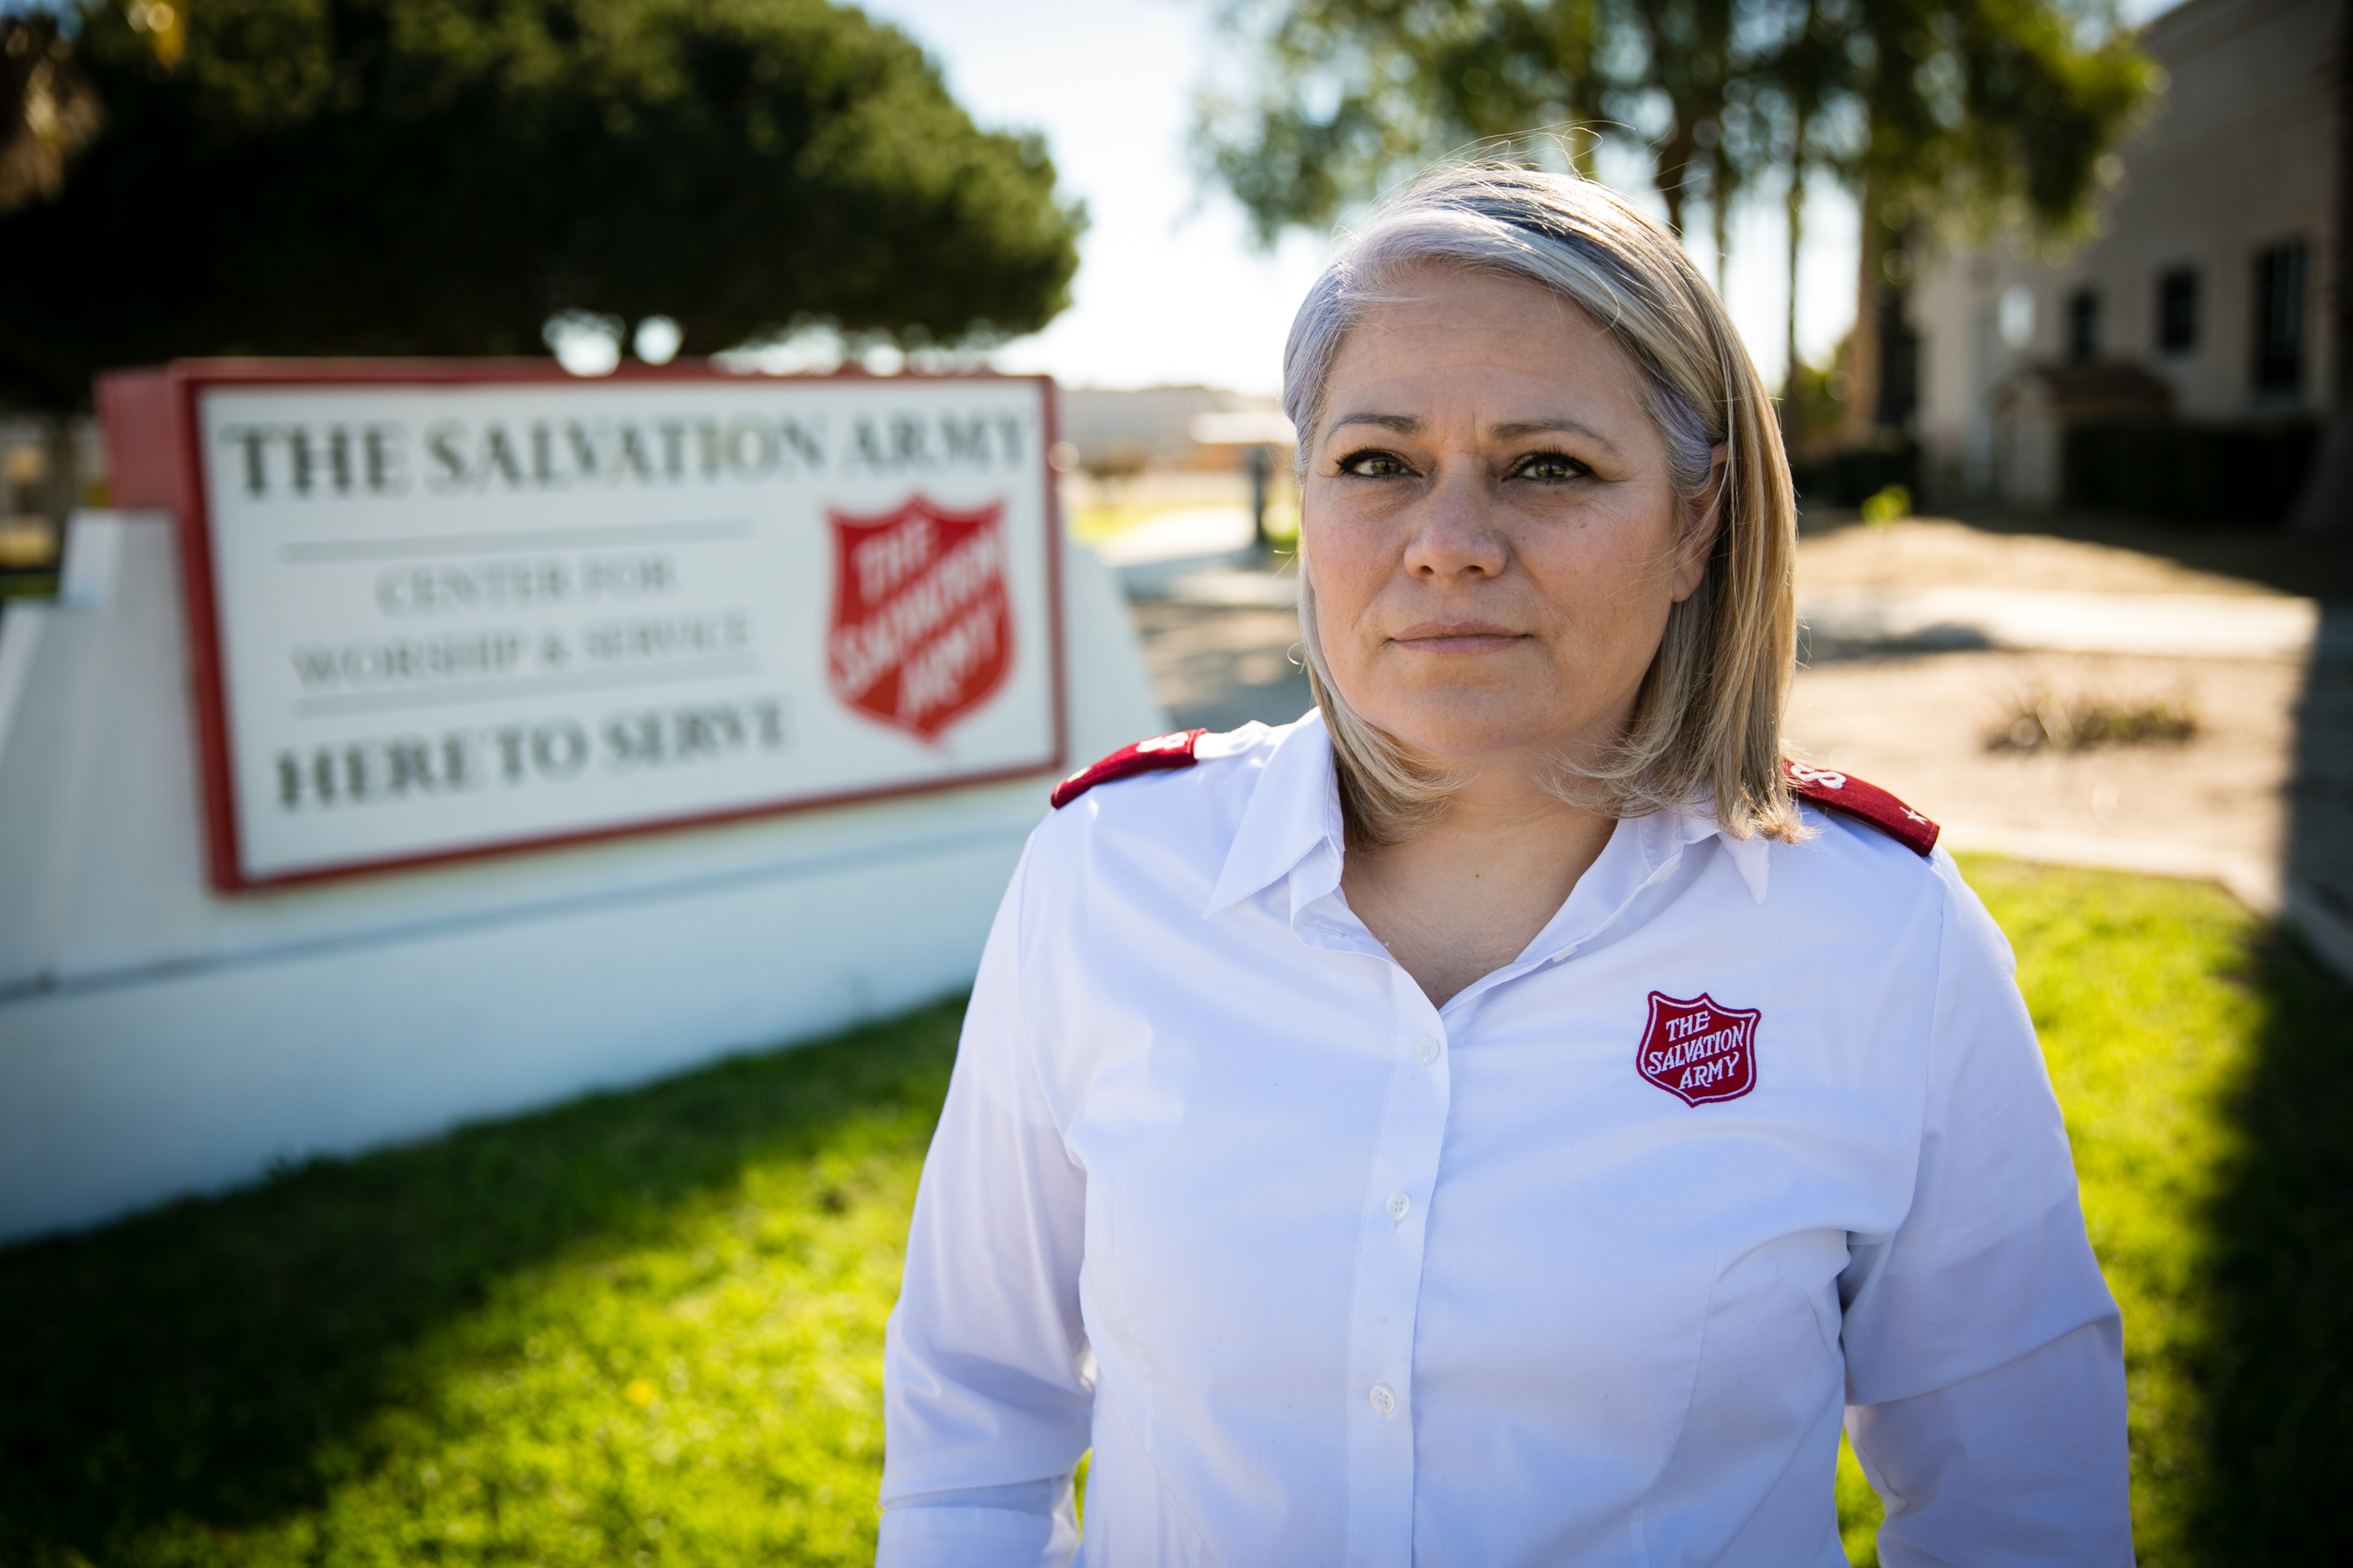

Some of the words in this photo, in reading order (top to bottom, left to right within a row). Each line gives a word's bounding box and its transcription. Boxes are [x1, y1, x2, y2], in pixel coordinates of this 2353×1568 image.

[225, 420, 409, 500] THE
[425, 413, 828, 494] SALVATION
[851, 408, 1035, 482] ARMY
[376, 559, 571, 617] CENTER
[276, 731, 488, 810] HERE
[496, 715, 588, 792] TO
[600, 697, 788, 776] SERVE
[1647, 1020, 1745, 1075] SALVATION
[1665, 1010, 1711, 1042] THE
[1679, 1051, 1740, 1089] ARMY
